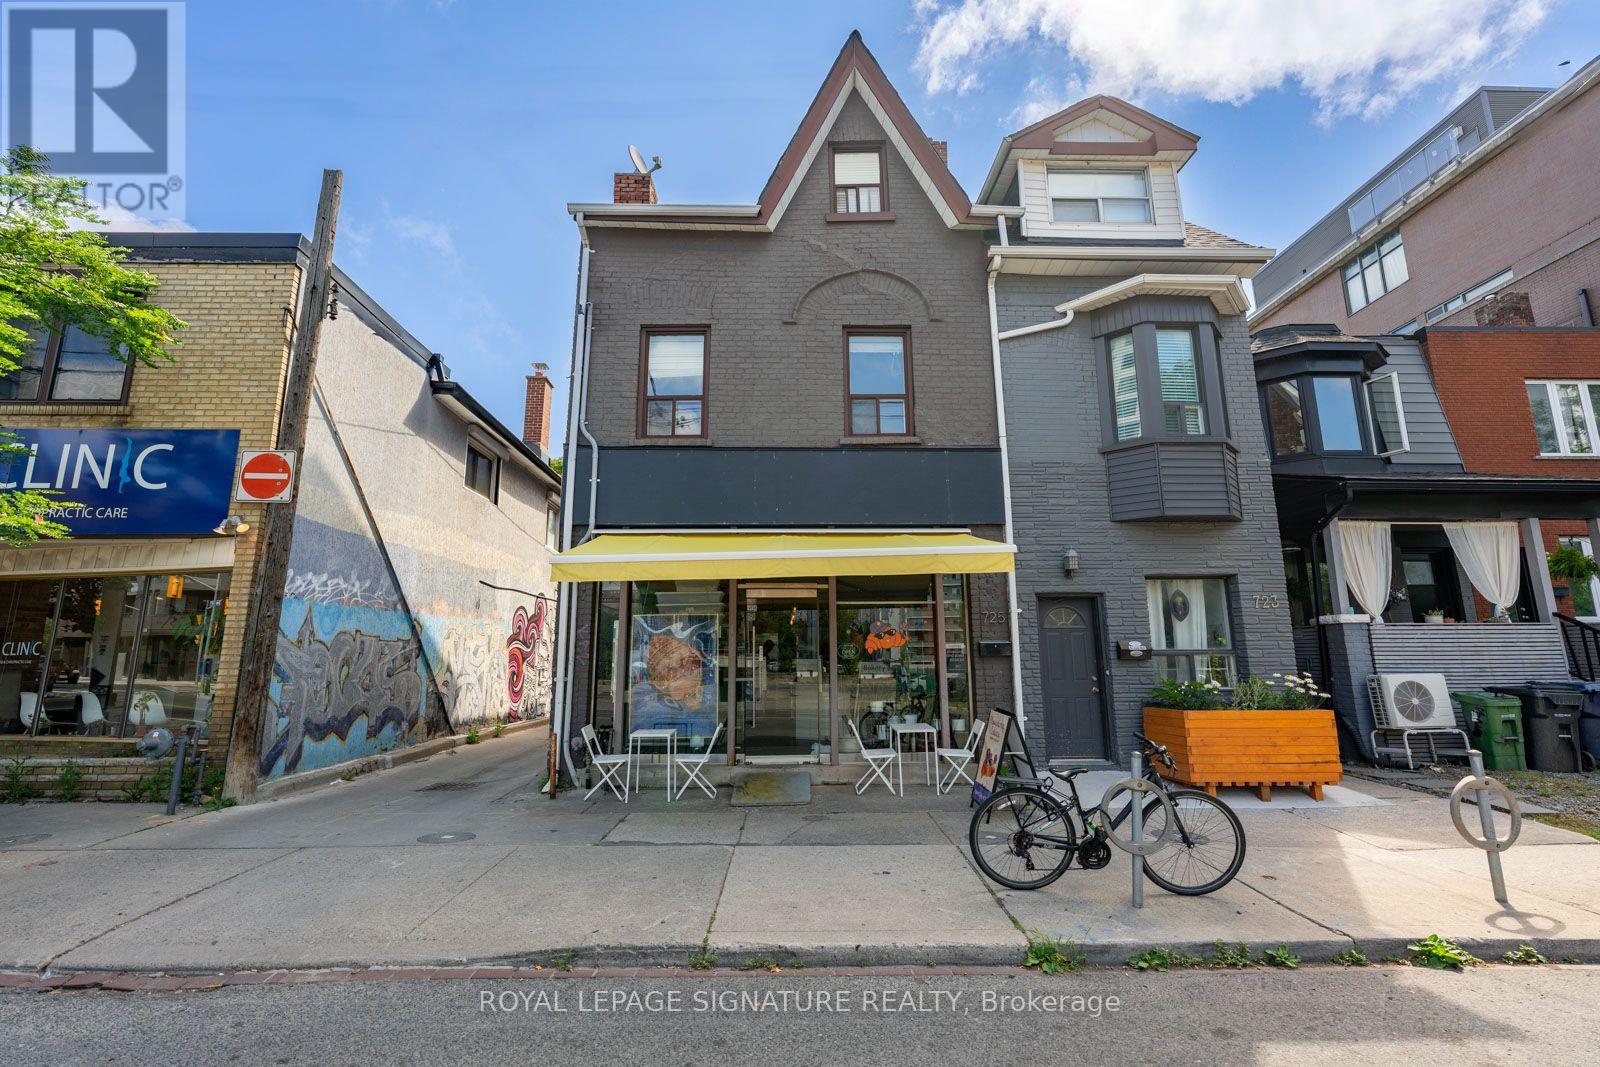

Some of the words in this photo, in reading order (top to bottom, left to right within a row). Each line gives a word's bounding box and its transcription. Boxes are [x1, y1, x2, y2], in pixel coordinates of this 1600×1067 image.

[40, 507, 93, 519] PRACTIC
[95, 507, 129, 519] CARE
[1252, 595, 1280, 609] 723
[982, 611, 1006, 623] 725
